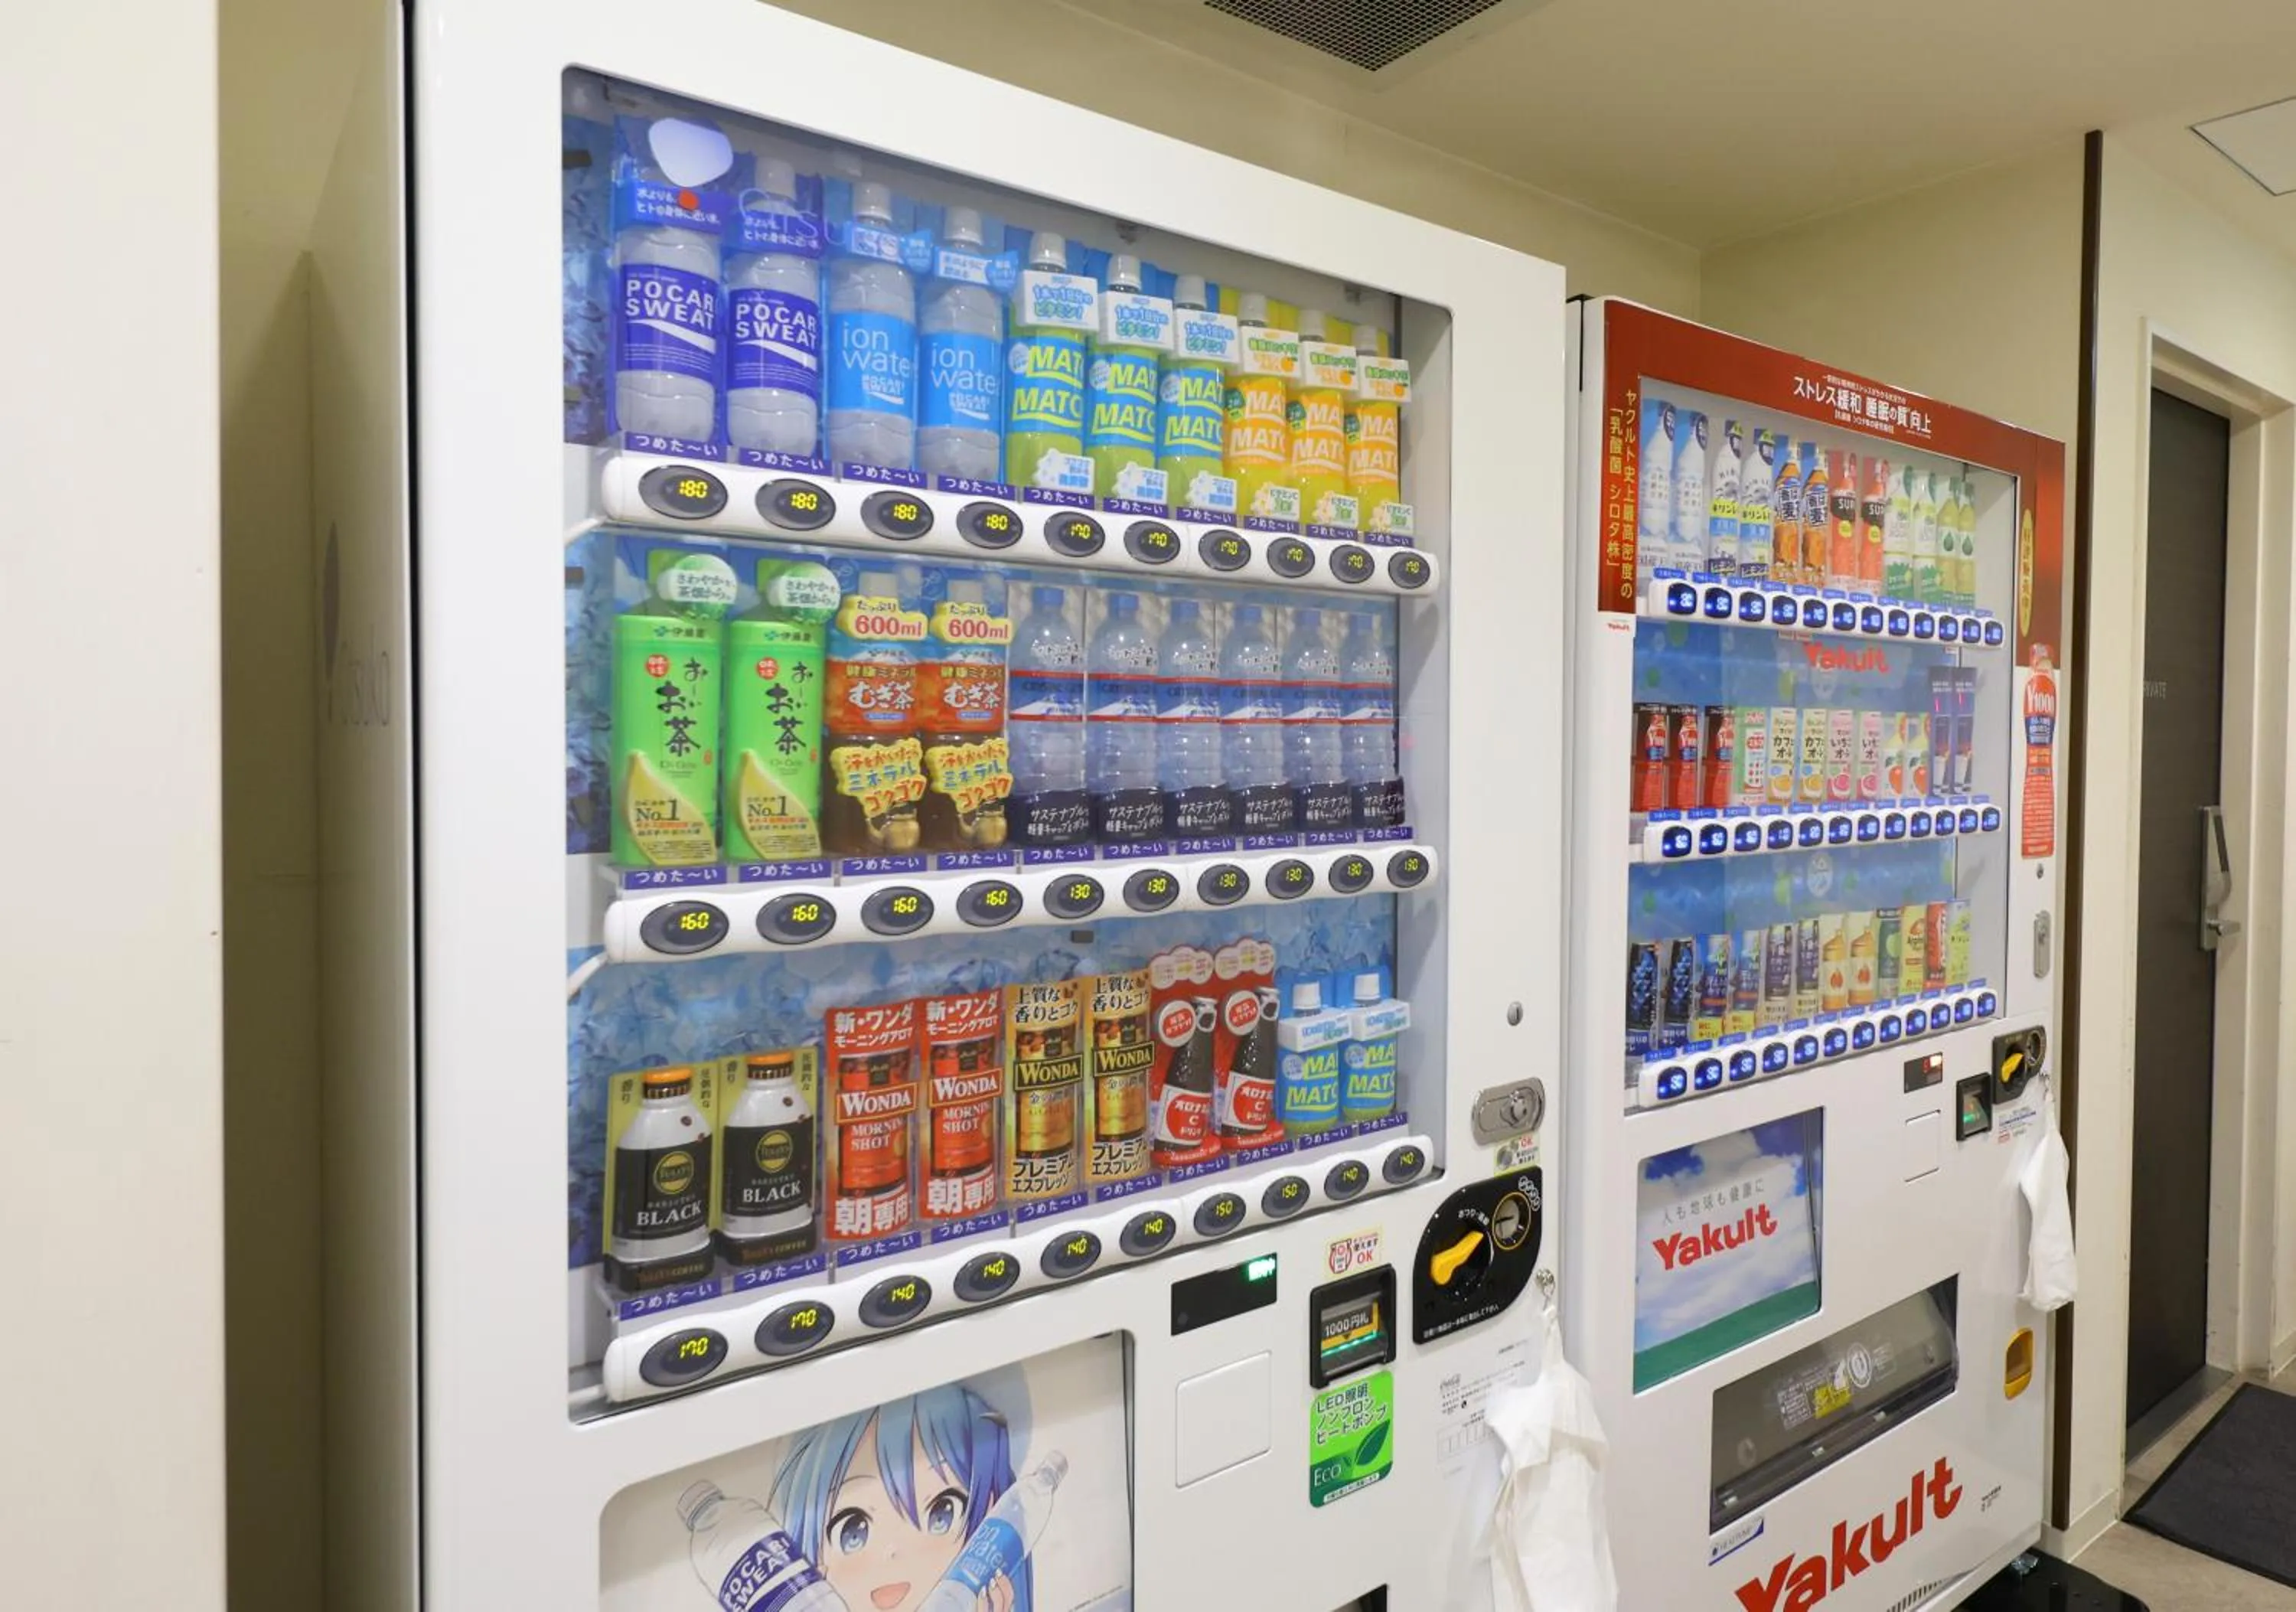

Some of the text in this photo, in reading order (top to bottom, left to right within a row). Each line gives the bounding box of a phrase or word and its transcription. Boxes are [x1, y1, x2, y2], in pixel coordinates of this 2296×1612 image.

[625, 299, 713, 330] SWEAT
[735, 321, 816, 351] SWEAT
[843, 321, 889, 351] ion
[931, 342, 974, 370] ion
[1793, 376, 1862, 414] ストレス緩和
[678, 479, 708, 498] 180
[791, 492, 818, 511] 180
[893, 504, 918, 520] 180
[986, 514, 1008, 530] 180
[855, 615, 923, 637] 600ml
[948, 618, 1009, 639] 600ml
[849, 761, 917, 791] ミネラル
[944, 759, 1002, 790] ミネラル
[1071, 883, 1091, 899] 130
[1148, 877, 1168, 894] 130
[893, 896, 918, 914] 160
[986, 889, 1008, 906] 160
[679, 911, 710, 932] 160
[792, 905, 819, 922] 160
[1098, 1049, 1150, 1072] WONDA
[1019, 1062, 1078, 1085] WONDA
[934, 1075, 998, 1101] WONDA
[842, 1089, 911, 1117] WONDA
[1254, 1101, 1265, 1111] C
[942, 1118, 980, 1134] SHOT
[1189, 1115, 1199, 1124] C
[851, 1134, 891, 1151] SHOT
[742, 1181, 801, 1203] BLACK
[927, 1173, 995, 1215] 朝専用
[636, 1200, 702, 1226] BLACK
[834, 1192, 909, 1235] 朝専用
[1144, 1218, 1165, 1235] 140
[1652, 1204, 1778, 1271] Yakult
[1066, 1237, 1088, 1255] 140
[984, 1260, 1006, 1277] 140
[1357, 1251, 1373, 1264] OK
[892, 1283, 916, 1300] 140
[790, 1307, 818, 1328] 170
[1325, 1310, 1369, 1336] 1000円札
[679, 1336, 710, 1358] 170
[1316, 1382, 1368, 1413] LED照明
[1317, 1398, 1374, 1428] ノンフロン
[1733, 1456, 1964, 1612] Yakult
